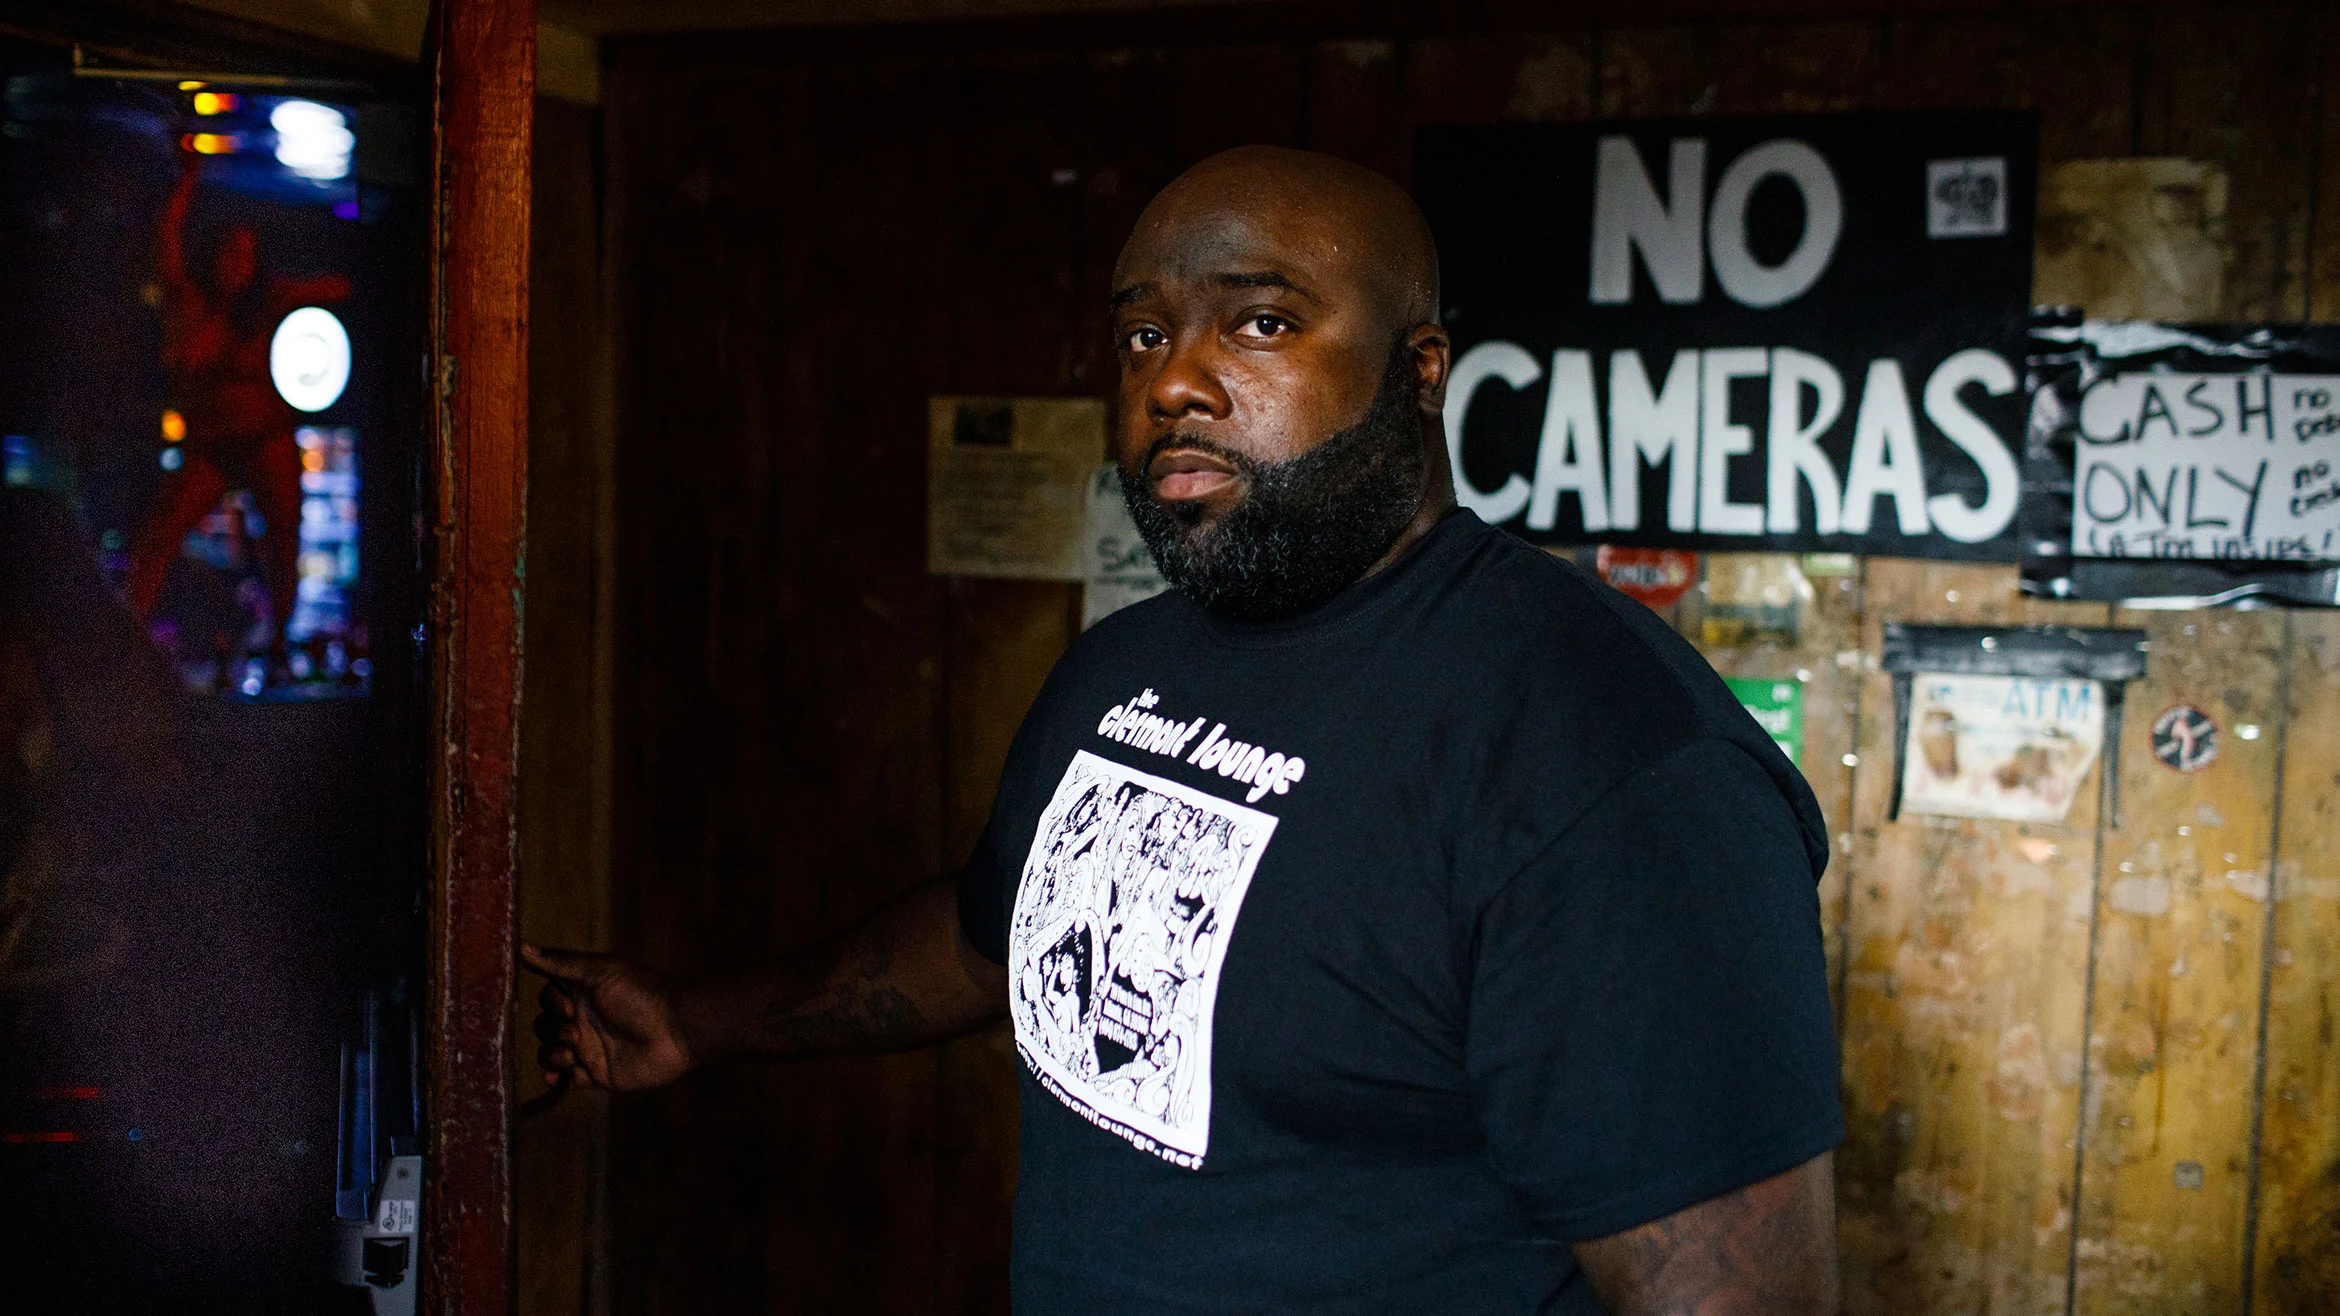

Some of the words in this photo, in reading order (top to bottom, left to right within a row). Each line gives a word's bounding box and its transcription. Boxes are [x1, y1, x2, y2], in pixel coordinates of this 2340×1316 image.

[1588, 135, 1844, 309] NO
[1446, 340, 2022, 544] CAMERAS
[2078, 374, 2275, 445] CASH
[2084, 459, 2268, 543] ONLY
[1137, 688, 1160, 709] the
[2002, 679, 2091, 721] ATM
[1186, 722, 1306, 803] lounge
